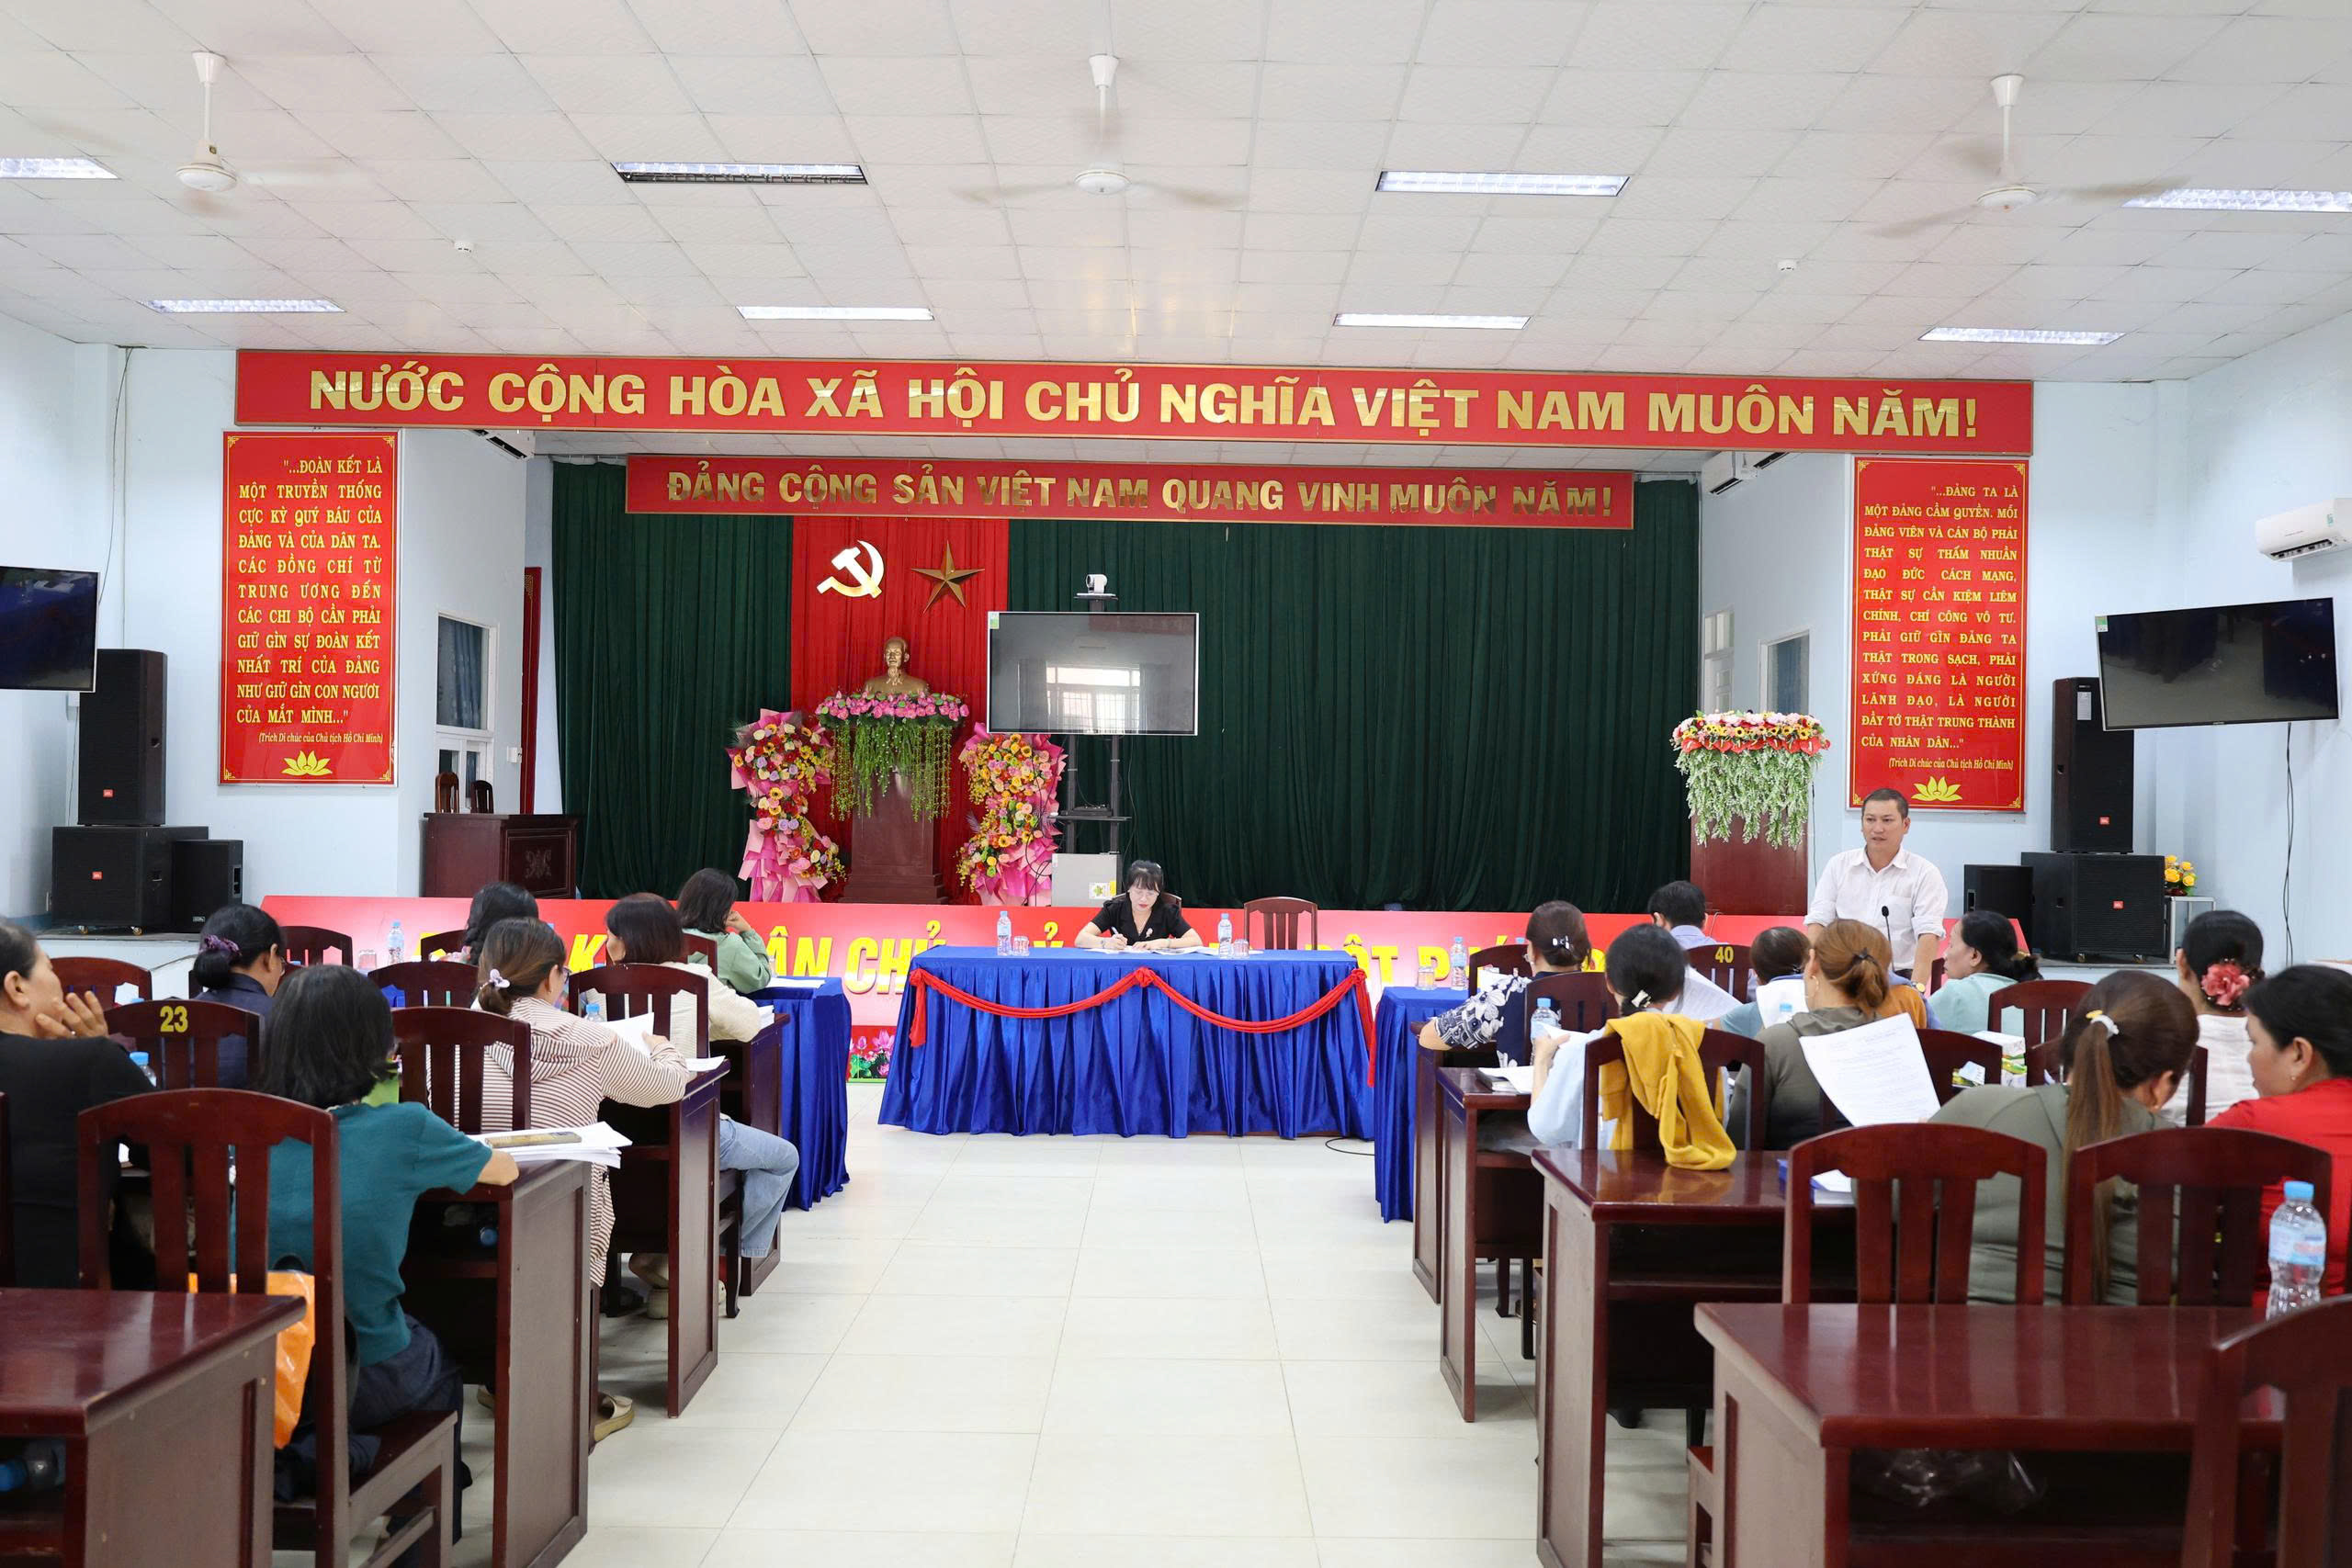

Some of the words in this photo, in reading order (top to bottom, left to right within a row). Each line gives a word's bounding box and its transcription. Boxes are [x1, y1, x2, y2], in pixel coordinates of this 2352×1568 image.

[310, 360, 464, 412] NƯỚC
[488, 363, 646, 423] CỘNG
[669, 365, 786, 417] HÒA
[804, 369, 884, 418] XÃ
[908, 367, 1004, 428] HỘI
[1024, 367, 1140, 423] CHỦ
[1159, 375, 1336, 427] NGHĨA
[1351, 378, 1480, 437] VIỆT
[1497, 389, 1625, 431] NAM
[1647, 383, 1815, 434] MUÔN
[1833, 388, 1977, 438] NĂM!
[337, 454, 362, 473] KẾT
[368, 456, 382, 473] LÀ
[240, 481, 266, 502] MỘT
[277, 479, 328, 499] TRUYỀN
[338, 479, 381, 499] THỐNG
[667, 460, 765, 502] ĐẢNG
[779, 464, 877, 510] CỘNG
[891, 463, 964, 505] SẢN
[977, 469, 1057, 513] VIỆT
[1067, 478, 1148, 509] NAM
[1162, 479, 1283, 514] QUANG
[1296, 481, 1380, 513] VINH
[1389, 476, 1498, 515] MUÔN
[1512, 479, 1612, 517] NĂM!
[1983, 487, 1997, 497] TA
[2005, 485, 2018, 497] LÀ
[239, 508, 263, 526] CỰC
[271, 506, 288, 524] KỲ
[295, 506, 320, 526] QUÝ
[326, 505, 350, 524] BÁU
[357, 505, 382, 524] CỦA
[1865, 503, 1888, 518] MỘT
[1892, 503, 1922, 516] ĐẢNG
[239, 530, 272, 548] ĐẢNG
[277, 531, 295, 548] VÀ
[300, 530, 325, 548] CỦA
[331, 532, 356, 548] DÂN
[362, 535, 380, 548] TA.
[1864, 524, 1894, 536] ĐẢNG
[1898, 525, 1925, 537] VIÊN
[1928, 525, 1943, 537] VÀ
[1947, 526, 1969, 538] CÁN
[1973, 526, 1987, 541] BỘ
[1992, 526, 2018, 539] PHẢI
[1864, 546, 1894, 560] THẬT
[1908, 547, 1923, 560] SỰ
[1938, 546, 1969, 558] THẤM
[239, 556, 266, 573] CÁC
[277, 554, 316, 573] ĐỒNG
[327, 556, 353, 573] CHÍ
[364, 556, 381, 573] TỪ
[1864, 569, 1886, 581] ĐẠO
[1903, 567, 1925, 580] ĐỨC
[1941, 568, 1971, 581] CÁCH
[1982, 570, 2016, 583] MẠNG,
[238, 584, 288, 598] TRUNG
[300, 582, 340, 598] ƯƠNG
[352, 579, 381, 598] ĐẾN
[1863, 588, 1893, 602] THẬT
[1901, 589, 1916, 603] SỰ
[1923, 586, 1945, 601] CẦN
[1953, 589, 1982, 604] KIỆM
[1990, 590, 2017, 603] LIÊM
[238, 605, 262, 623] CÁC
[269, 610, 290, 623] CHI
[298, 606, 313, 626] BỘ
[322, 604, 345, 623] CẦN
[353, 605, 380, 624] PHẢI
[1863, 608, 1901, 622] CHÍNH,
[1910, 609, 1929, 621] CHÍ
[1938, 610, 1967, 622] CÔNG
[1976, 611, 1990, 623] VÔ
[1999, 612, 2016, 623] TƯ.
[238, 631, 259, 648] GIỮ
[266, 630, 287, 649] GÌN
[294, 632, 310, 651] SỰ
[316, 631, 348, 649] ĐOÀN
[356, 629, 380, 649] KẾT
[1863, 628, 1891, 641] PHẢI
[1900, 630, 1921, 642] GIỮ
[1927, 630, 1951, 643] GÌN
[1960, 630, 1992, 644] ĐẢNG
[2001, 635, 2017, 644] TA
[238, 654, 271, 672] NHẤT
[280, 656, 301, 673] TRÍ
[311, 655, 336, 673] CỦA
[345, 655, 379, 674] ĐẢNG
[1862, 650, 1893, 665] THẬT
[1901, 653, 1939, 663] TRONG
[1948, 654, 1980, 666] SẠCH,
[1990, 652, 2016, 665] PHẢI
[1862, 671, 1896, 683] XỨNG
[1906, 671, 1941, 684] ĐÁNG
[1951, 673, 1967, 685] LÀ
[1977, 673, 2016, 686] NGƯỜI
[237, 682, 263, 698] NHƯ
[266, 682, 287, 698] GIỮ
[290, 681, 311, 698] GÌN
[315, 684, 338, 698] CON
[1906, 695, 1938, 707] ĐẠO,
[1949, 694, 1964, 705] LÀ
[1974, 694, 2015, 707] NGƯỜI
[237, 705, 261, 723] CỦA
[267, 704, 294, 723] MẮT
[1905, 715, 1934, 728] THẬT
[1937, 716, 1973, 728] TRUNG
[1977, 716, 2015, 728] THÀNH
[1861, 733, 1883, 747] CỦA
[1890, 735, 1920, 749] NHÂN
[766, 926, 832, 977] ÂN
[1714, 946, 1735, 964] 40
[160, 1005, 188, 1033] 23
